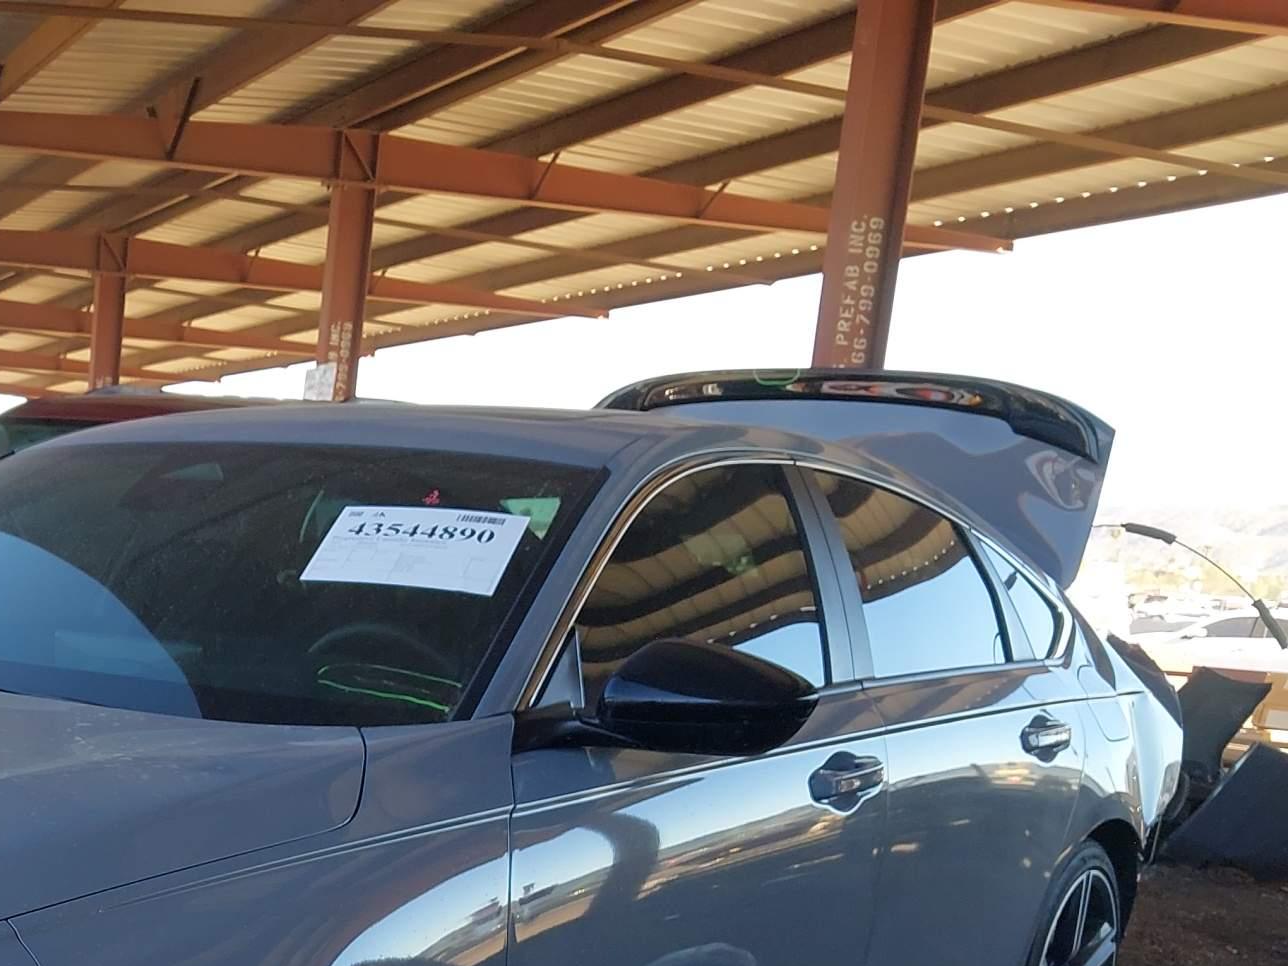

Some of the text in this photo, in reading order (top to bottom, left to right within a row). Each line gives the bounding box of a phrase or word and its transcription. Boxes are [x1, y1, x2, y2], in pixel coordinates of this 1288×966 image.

[834, 264, 861, 346] PREFAB
[848, 213, 868, 254] INC.
[348, 521, 496, 545] 43544890
